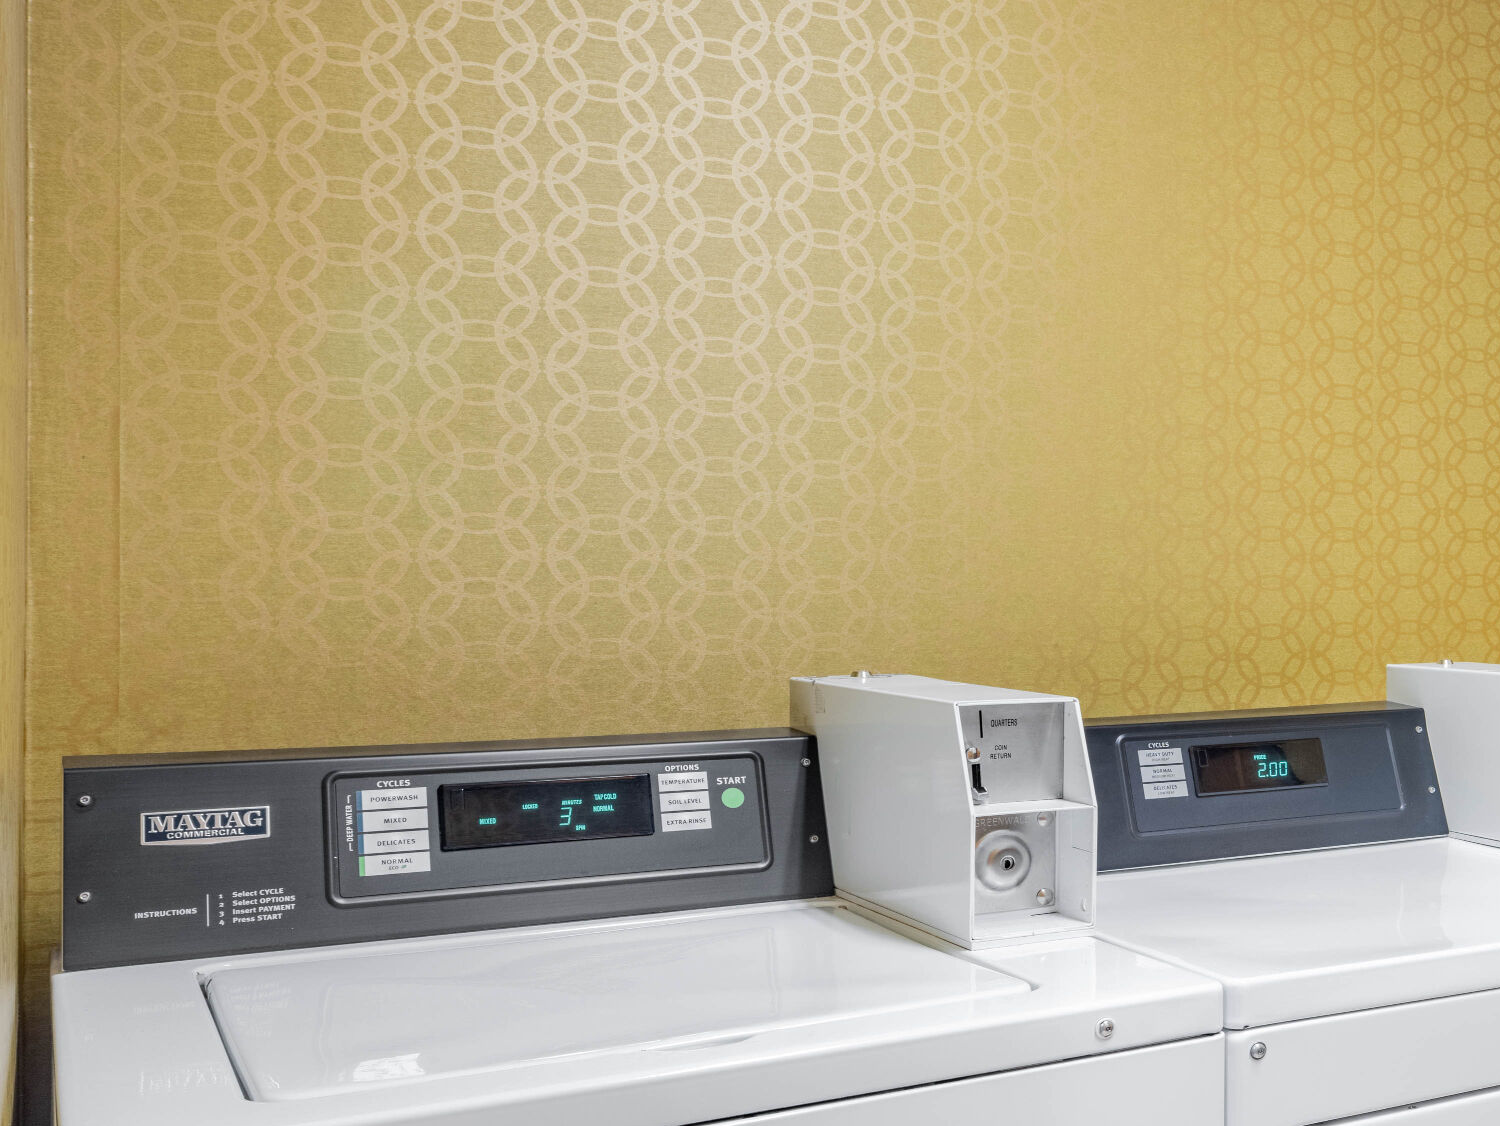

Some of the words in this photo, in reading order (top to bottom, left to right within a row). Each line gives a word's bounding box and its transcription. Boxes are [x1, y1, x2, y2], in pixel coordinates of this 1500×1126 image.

[990, 718, 1018, 728] QUARTERS
[1148, 741, 1170, 749] CYCLES
[989, 752, 1012, 760] RETURN
[664, 764, 700, 772] OPTIONS
[1257, 761, 1288, 778] 2.00
[376, 779, 411, 788] CYCLES
[716, 776, 747, 785] START
[370, 794, 419, 803] POWERWASH
[345, 804, 353, 826] WATER
[559, 806, 573, 826] 3
[148, 810, 264, 834] MAYTAG
[479, 817, 497, 825] MIXED
[166, 828, 245, 840] COMMERCIAL
[346, 826, 354, 842] DEEP
[377, 838, 416, 847] DELICATES
[232, 891, 258, 899] Select
[259, 887, 284, 896] CYCLE
[232, 899, 258, 907] Select
[259, 895, 296, 905] OPTIONS
[134, 907, 198, 920] INSTRUCTIONS
[258, 903, 296, 913] PAYMENT
[232, 916, 256, 924] Press
[257, 912, 282, 921] START
